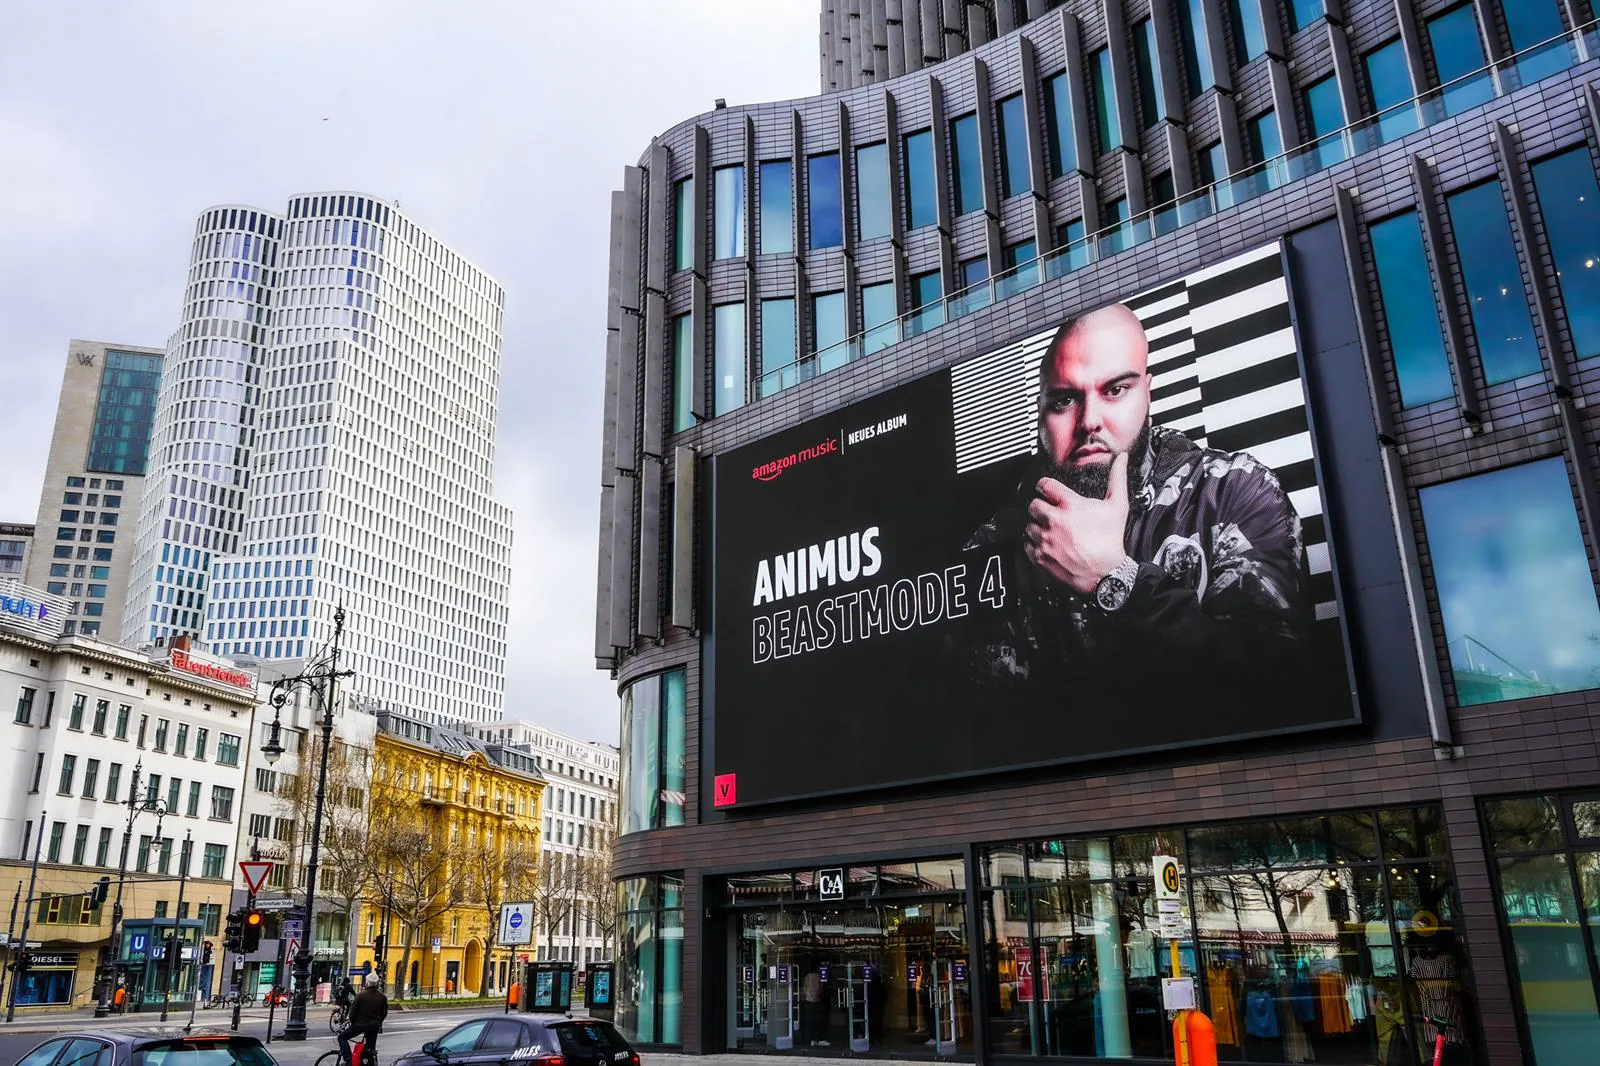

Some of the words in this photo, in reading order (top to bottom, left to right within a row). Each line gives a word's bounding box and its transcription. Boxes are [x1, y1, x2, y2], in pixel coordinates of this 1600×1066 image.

[848, 424, 876, 446] NEUES
[876, 413, 908, 435] ALBUM
[752, 453, 797, 481] amazon
[798, 437, 838, 463] music
[752, 526, 883, 607] ANIMUS
[752, 564, 969, 665] BEASTMODE
[978, 555, 1007, 609] 4
[720, 783, 730, 798] V
[820, 874, 843, 895] C&A
[1167, 868, 1178, 887] H
[134, 936, 145, 950] U
[153, 948, 161, 957] U
[511, 1045, 541, 1060] MILES
[614, 1051, 629, 1062] MILES
